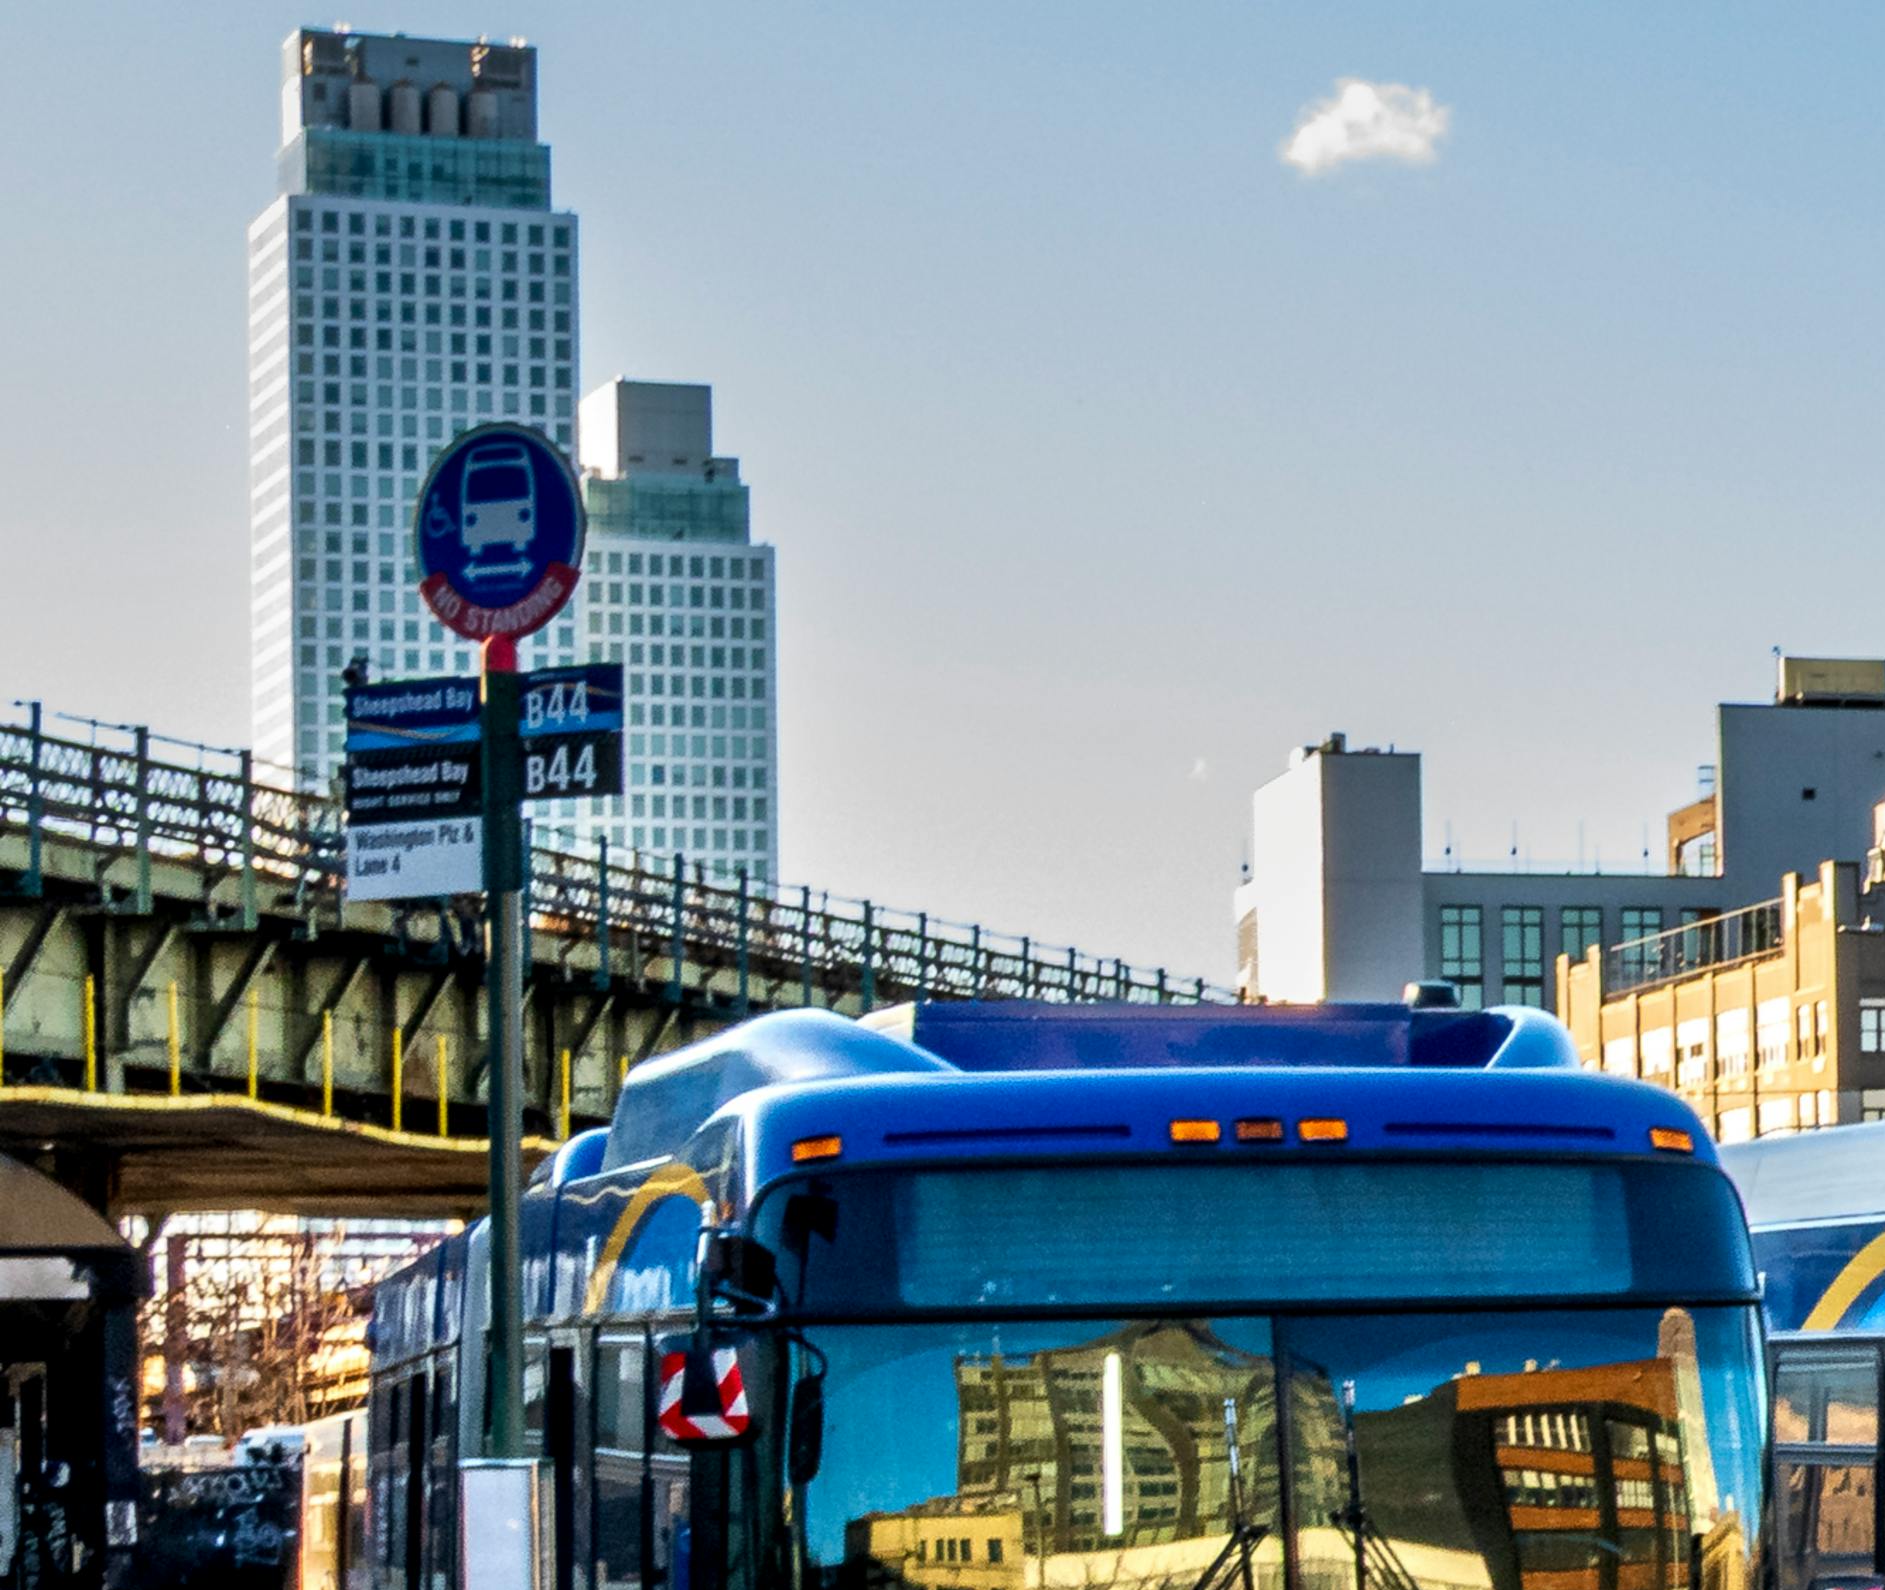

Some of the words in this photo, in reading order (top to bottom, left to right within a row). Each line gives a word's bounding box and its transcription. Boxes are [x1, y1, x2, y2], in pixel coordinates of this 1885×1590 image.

[432, 585, 462, 620] NO
[465, 577, 564, 634] STANDING
[353, 689, 442, 717] Sheepshead
[446, 686, 474, 711] Bay
[526, 680, 590, 729] B44
[352, 762, 439, 790] Sheepshead
[441, 760, 469, 785] Bay
[526, 743, 597, 794] B44
[356, 857, 388, 877] Lane
[391, 855, 401, 873] 4
